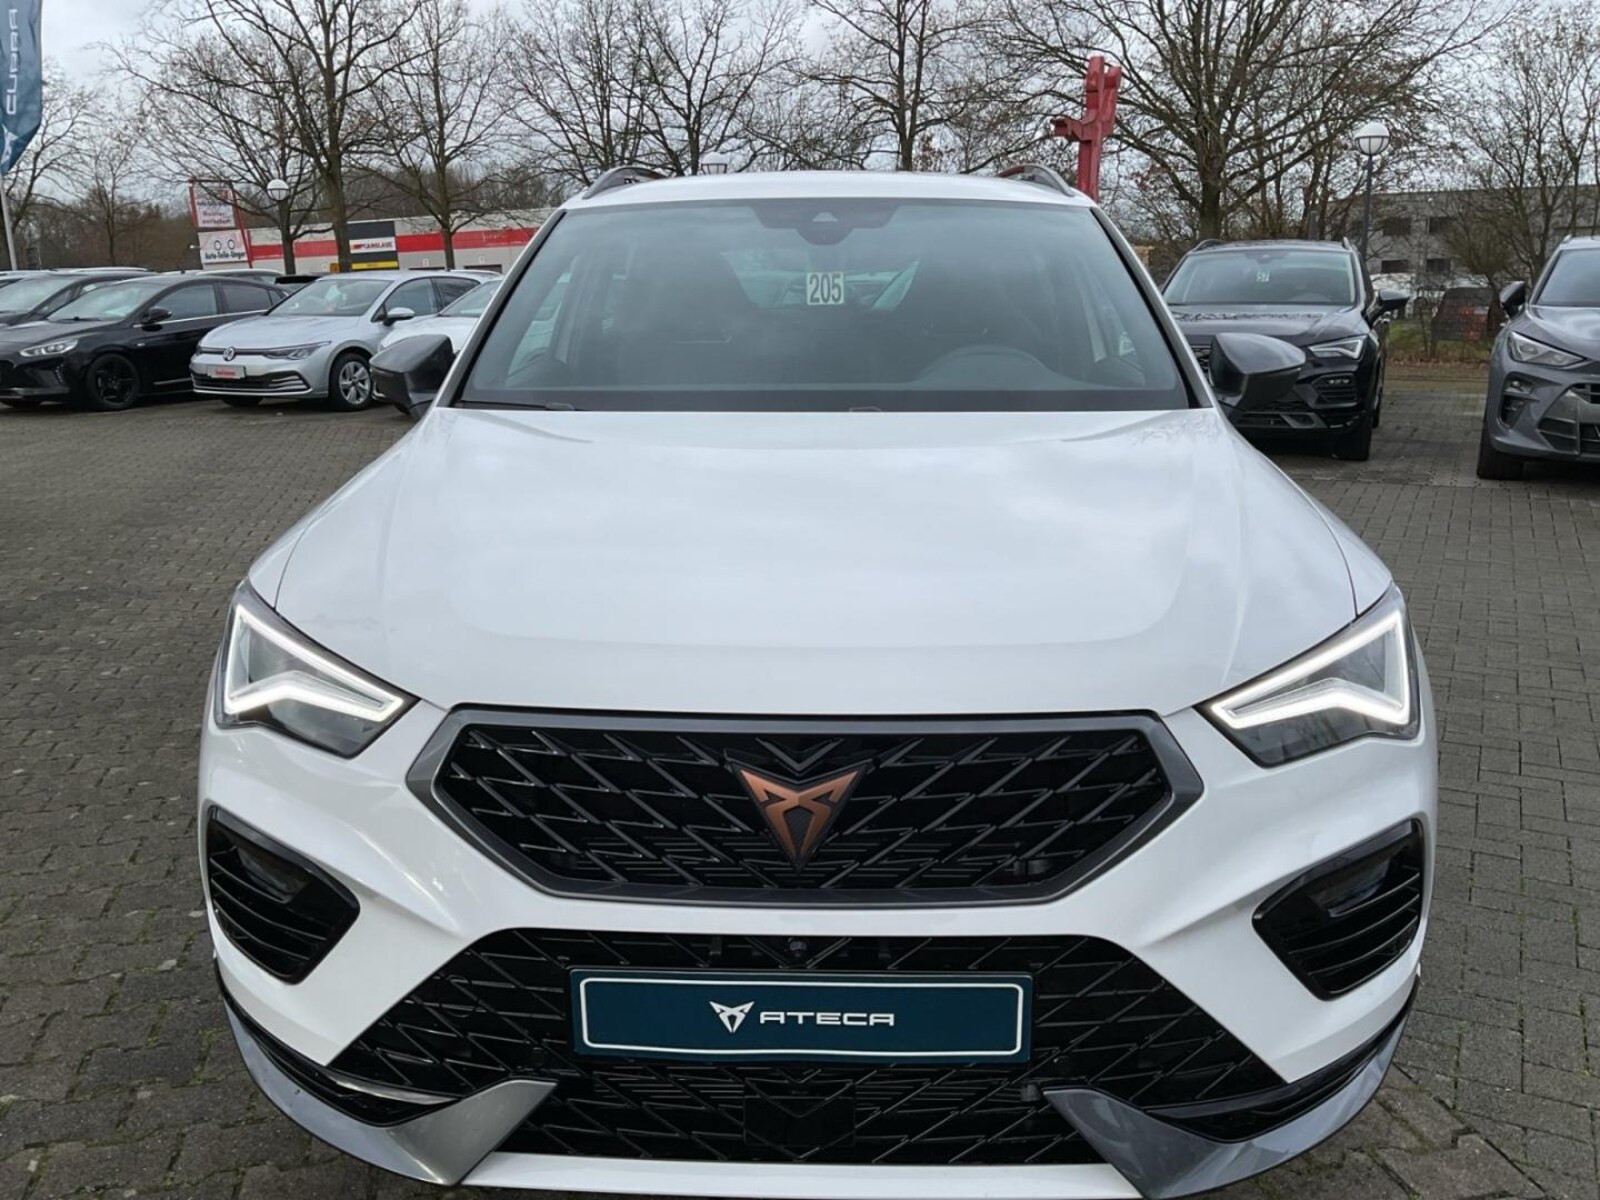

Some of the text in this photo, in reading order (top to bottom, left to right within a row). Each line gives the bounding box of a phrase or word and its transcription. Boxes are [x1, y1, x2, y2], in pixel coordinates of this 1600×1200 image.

[6, 9, 18, 115] CUPRA
[809, 272, 842, 303] 205
[760, 1011, 895, 1026] ATECA
